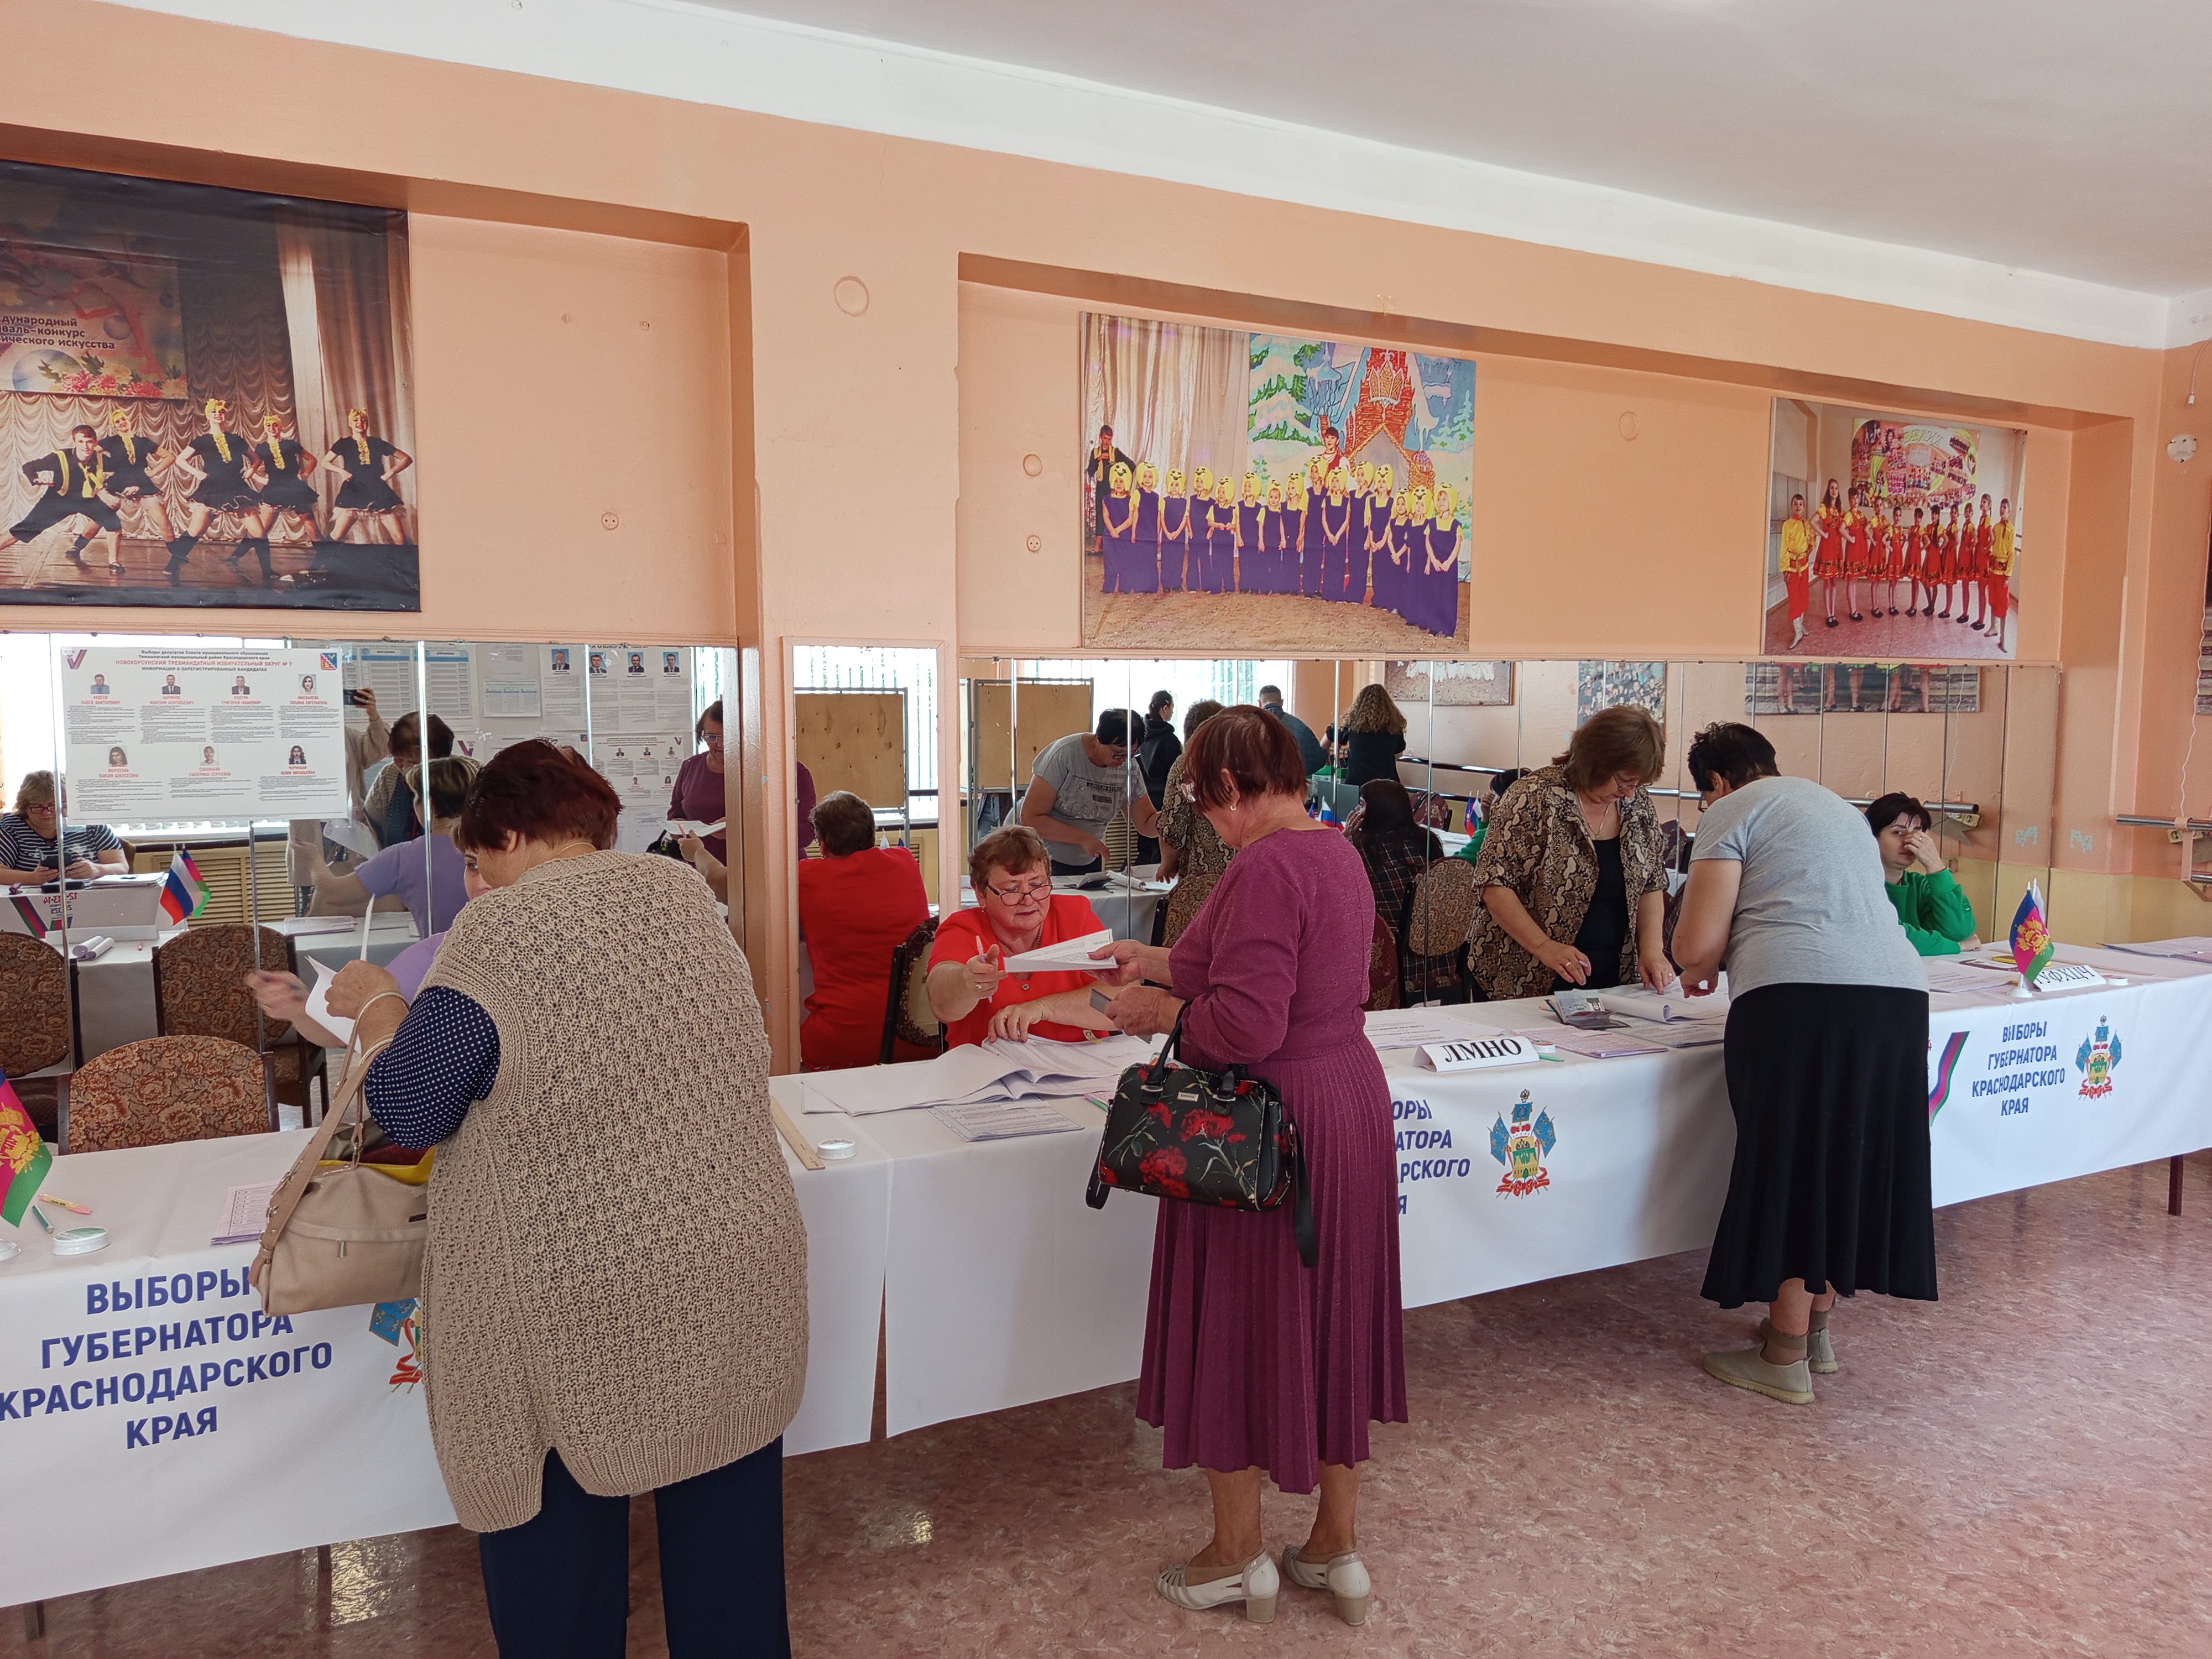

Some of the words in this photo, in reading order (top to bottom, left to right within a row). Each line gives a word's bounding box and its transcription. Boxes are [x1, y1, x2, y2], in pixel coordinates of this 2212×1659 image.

[0, 316, 77, 327] дународный
[0, 336, 55, 346] ического
[58, 338, 115, 349] искусства
[2002, 1021, 2048, 1043] ВЫБОРЫ
[1441, 1039, 1522, 1062] ЛМНО
[1987, 1045, 2057, 1070] ГУБЕРНАТОРА
[1972, 1067, 2065, 1097] КРАСНОДАРСКОГО
[1392, 1099, 1433, 1120] ОРЫ
[2001, 1097, 2029, 1117] КРАЯ
[1396, 1129, 1452, 1151] АТОРА
[1398, 1159, 1471, 1183] РСКОГО
[87, 1266, 251, 1314] ВЫБОРЫ
[41, 1310, 294, 1368] ГУБЕРНАТОРА
[0, 1342, 332, 1421] КРАСНОДАРСКОГО
[127, 1406, 217, 1449] КРАЯ
